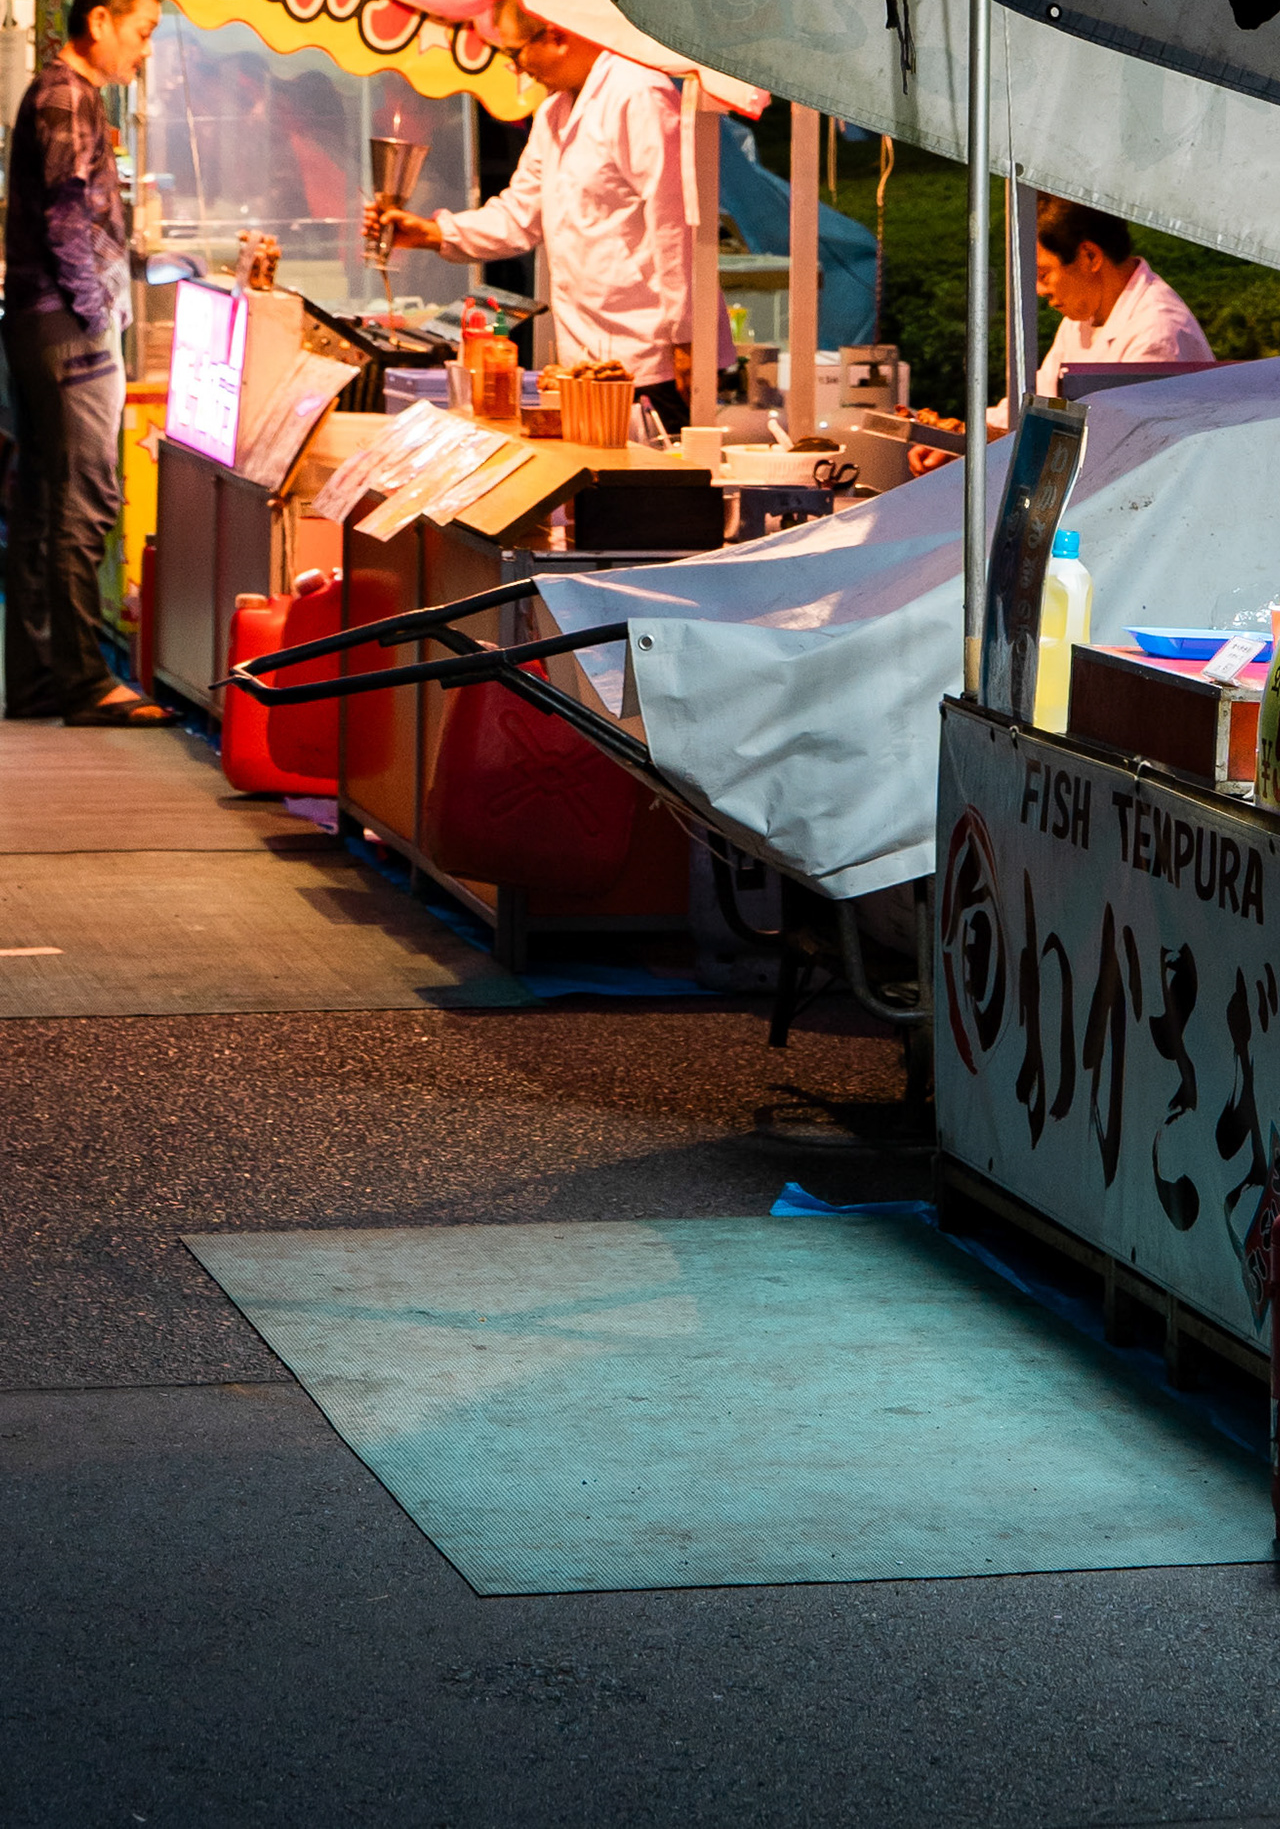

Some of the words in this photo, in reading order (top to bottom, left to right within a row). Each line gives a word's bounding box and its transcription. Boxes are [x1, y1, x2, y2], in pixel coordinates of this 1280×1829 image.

[1021, 758, 1092, 851] FISH
[1113, 790, 1265, 925] TEMPURA
[1016, 868, 1279, 1261] わかさぎ
